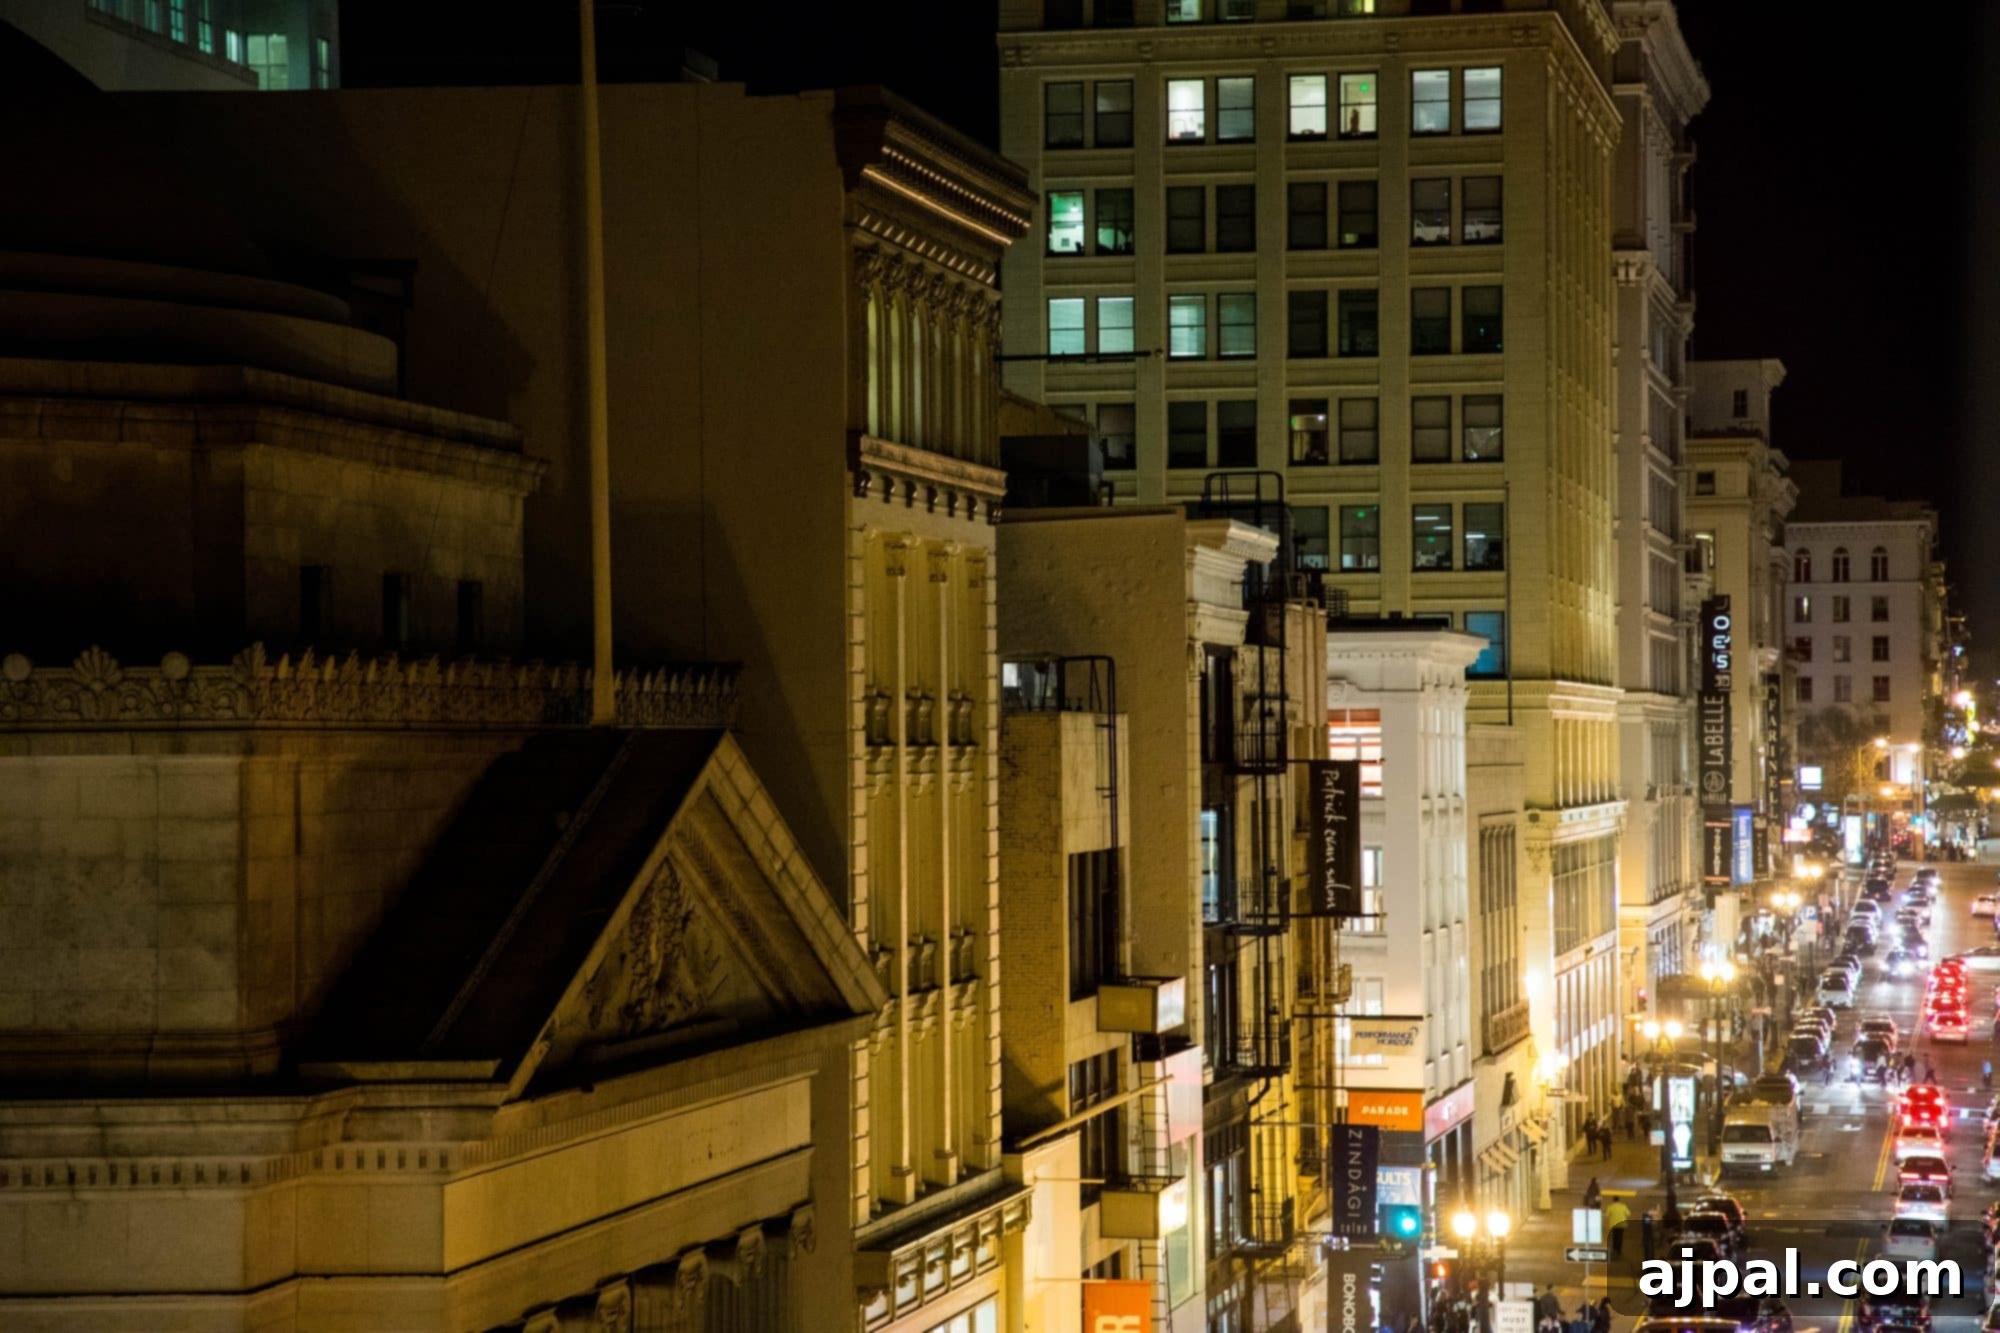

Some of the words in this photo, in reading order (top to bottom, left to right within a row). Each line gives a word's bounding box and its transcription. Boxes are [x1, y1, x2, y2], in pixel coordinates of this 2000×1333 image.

[1325, 868, 1351, 909] salon
[1805, 907, 1816, 920] P
[1355, 1031, 1413, 1040] PERFORMANCE
[1376, 1038, 1413, 1046] HORIZON
[1361, 1105, 1408, 1115] PARADE
